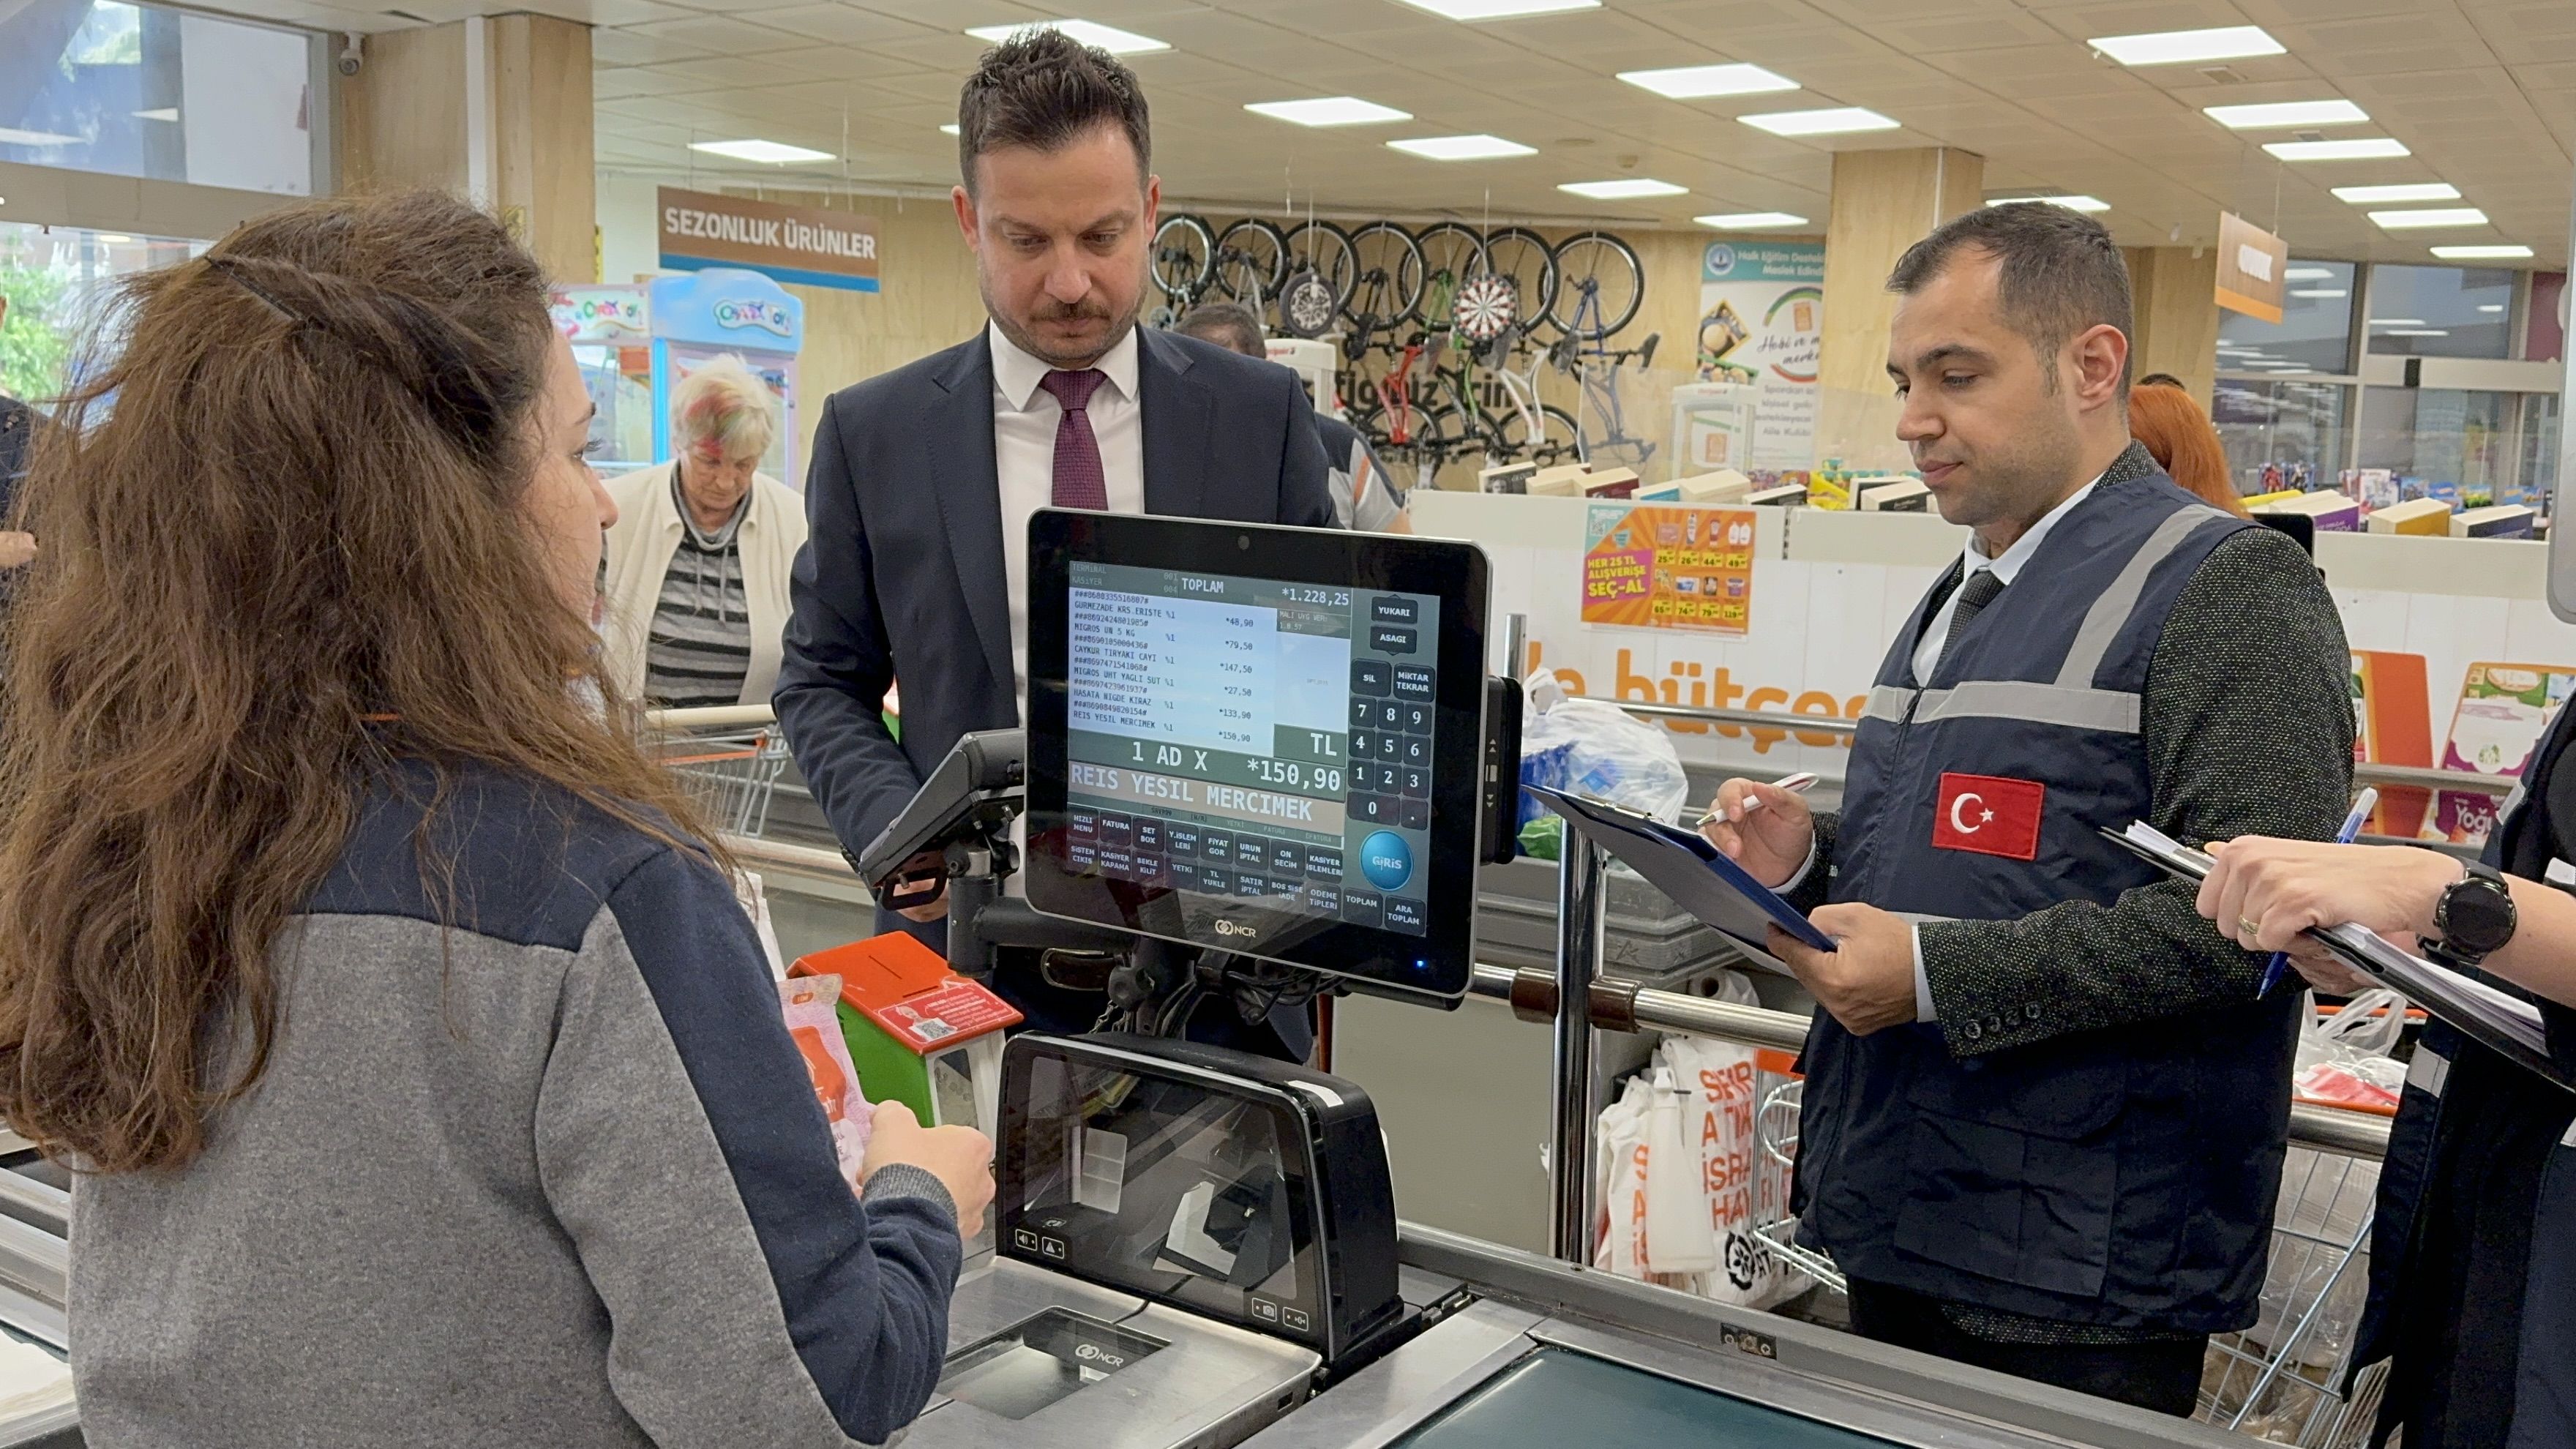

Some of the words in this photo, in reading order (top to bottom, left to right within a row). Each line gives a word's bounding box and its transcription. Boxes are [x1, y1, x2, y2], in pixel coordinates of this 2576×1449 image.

[664, 207, 780, 247] SEZONLUK
[784, 217, 876, 259] ÜRÜNLER
[1588, 558, 1607, 569] HER
[1611, 556, 1622, 566] 25
[1625, 555, 1636, 565] TL
[1182, 577, 1224, 593] TOPLAM
[1589, 579, 1645, 599] SEÇ-AL
[1075, 601, 1113, 612] GURMEZADE
[1379, 607, 1409, 617] YUKARI
[1075, 623, 1100, 633] MIGROS
[1379, 634, 1406, 643] ASAGI
[1074, 647, 1100, 655] CAYKUR
[1104, 649, 1134, 659] TIRYAKI
[1139, 654, 1156, 662] CAYI
[1074, 667, 1099, 678] MIGROS
[1104, 670, 1116, 679] UHT
[1121, 673, 1143, 682] YAGLI
[1147, 676, 1161, 684] SUT
[1396, 682, 1429, 692] TEKRAR
[1104, 693, 1125, 703] NIGDE
[1129, 697, 1151, 705] KIRAZ
[1358, 704, 1366, 717] 7
[1387, 708, 1395, 721] 8
[1074, 711, 1090, 720] REIS
[1095, 714, 1116, 724] YESIL
[1120, 717, 1156, 729] MERCIMEK
[1412, 711, 1420, 724] 9
[1310, 733, 1336, 756] TL
[1356, 736, 1365, 749] 4
[1385, 739, 1393, 752] 5
[1411, 744, 1419, 756] 6
[1133, 742, 1143, 761] 1
[1156, 745, 1182, 767] AD
[1194, 750, 1208, 771] X
[1357, 767, 1363, 780] 1
[1385, 771, 1392, 784] 2
[1410, 774, 1418, 787] 3
[1071, 765, 1118, 789] REIS
[1131, 774, 1194, 802] YESIL
[1207, 786, 1312, 821] MERCIMEK
[1368, 802, 1377, 815] 0
[1074, 815, 1093, 823] HIZLI
[1102, 820, 1129, 830] FATURA
[1074, 824, 1093, 833] MENU
[1141, 836, 1156, 844] BOX
[1209, 847, 1225, 856] GOR
[1240, 843, 1261, 853] URUN
[1073, 855, 1093, 864] CIKIS
[1137, 858, 1158, 866] BEKLE
[1101, 861, 1129, 871] KAPAMA
[1203, 878, 1226, 888] YUKLE
[1240, 877, 1263, 886] SATIR
[1272, 882, 1286, 890] BOS
[1311, 889, 1337, 900] ODEME
[1346, 895, 1377, 907] TOPLAM
[1395, 905, 1412, 913] ARA
[1388, 913, 1419, 925] TOPLAM
[1235, 926, 1256, 937] NCR
[1096, 1352, 1123, 1366] NCR
